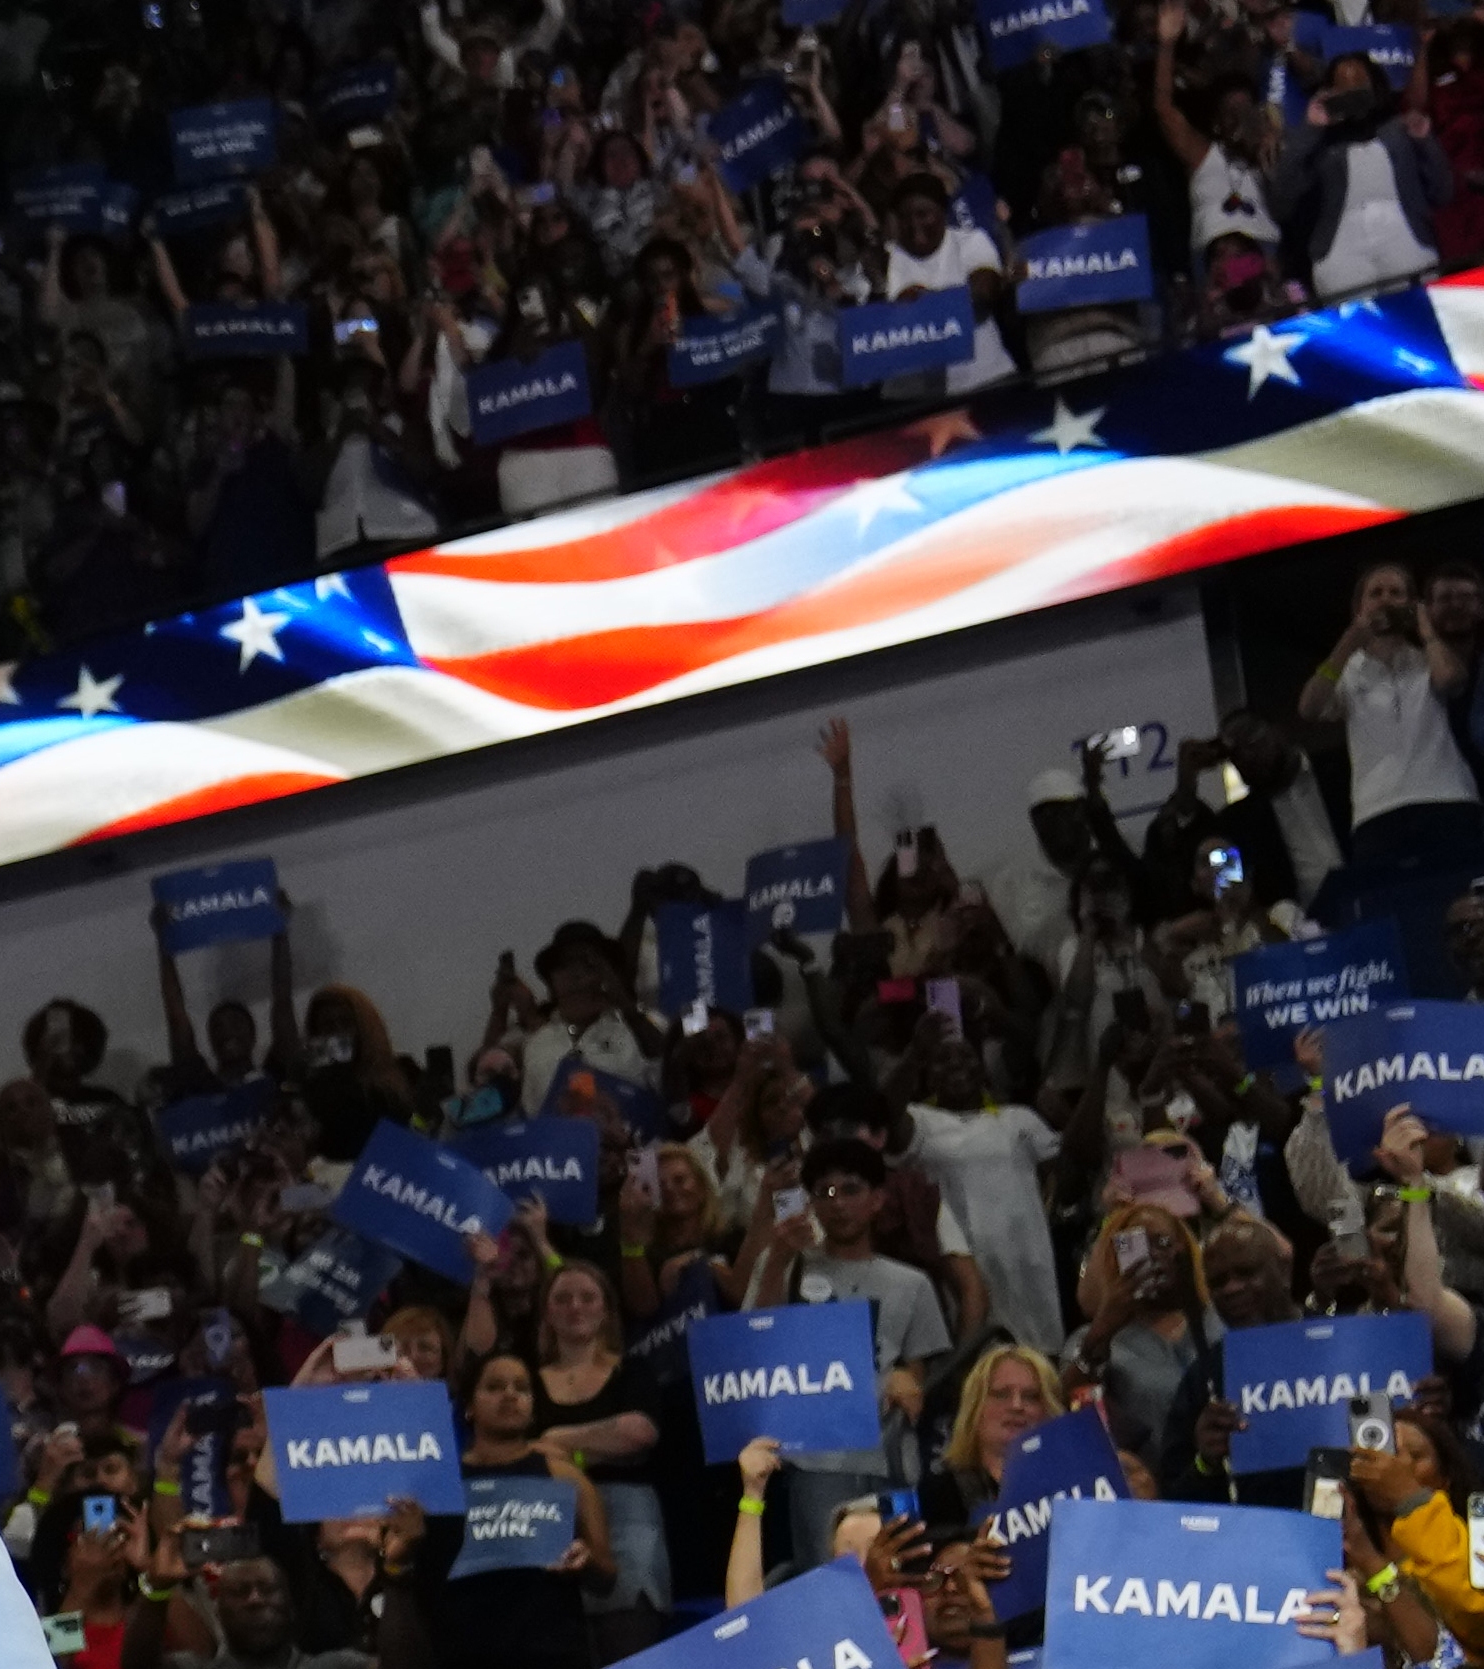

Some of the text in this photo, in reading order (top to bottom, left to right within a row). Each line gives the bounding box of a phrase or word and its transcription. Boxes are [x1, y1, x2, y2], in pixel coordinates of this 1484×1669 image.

[1026, 249, 1138, 283] KAMALA
[852, 318, 963, 355] KAMALA
[477, 374, 578, 416] KAMALA
[1264, 993, 1378, 1030] WE WIN.
[1335, 1052, 1484, 1104] KAMALA
[484, 1157, 582, 1186] MALA
[361, 1166, 481, 1236] KAMALA
[704, 1361, 853, 1406] KAMALA
[286, 1432, 443, 1470] KAMALA
[987, 1477, 1116, 1546] KAMA
[1073, 1575, 1313, 1626] KAMALA
